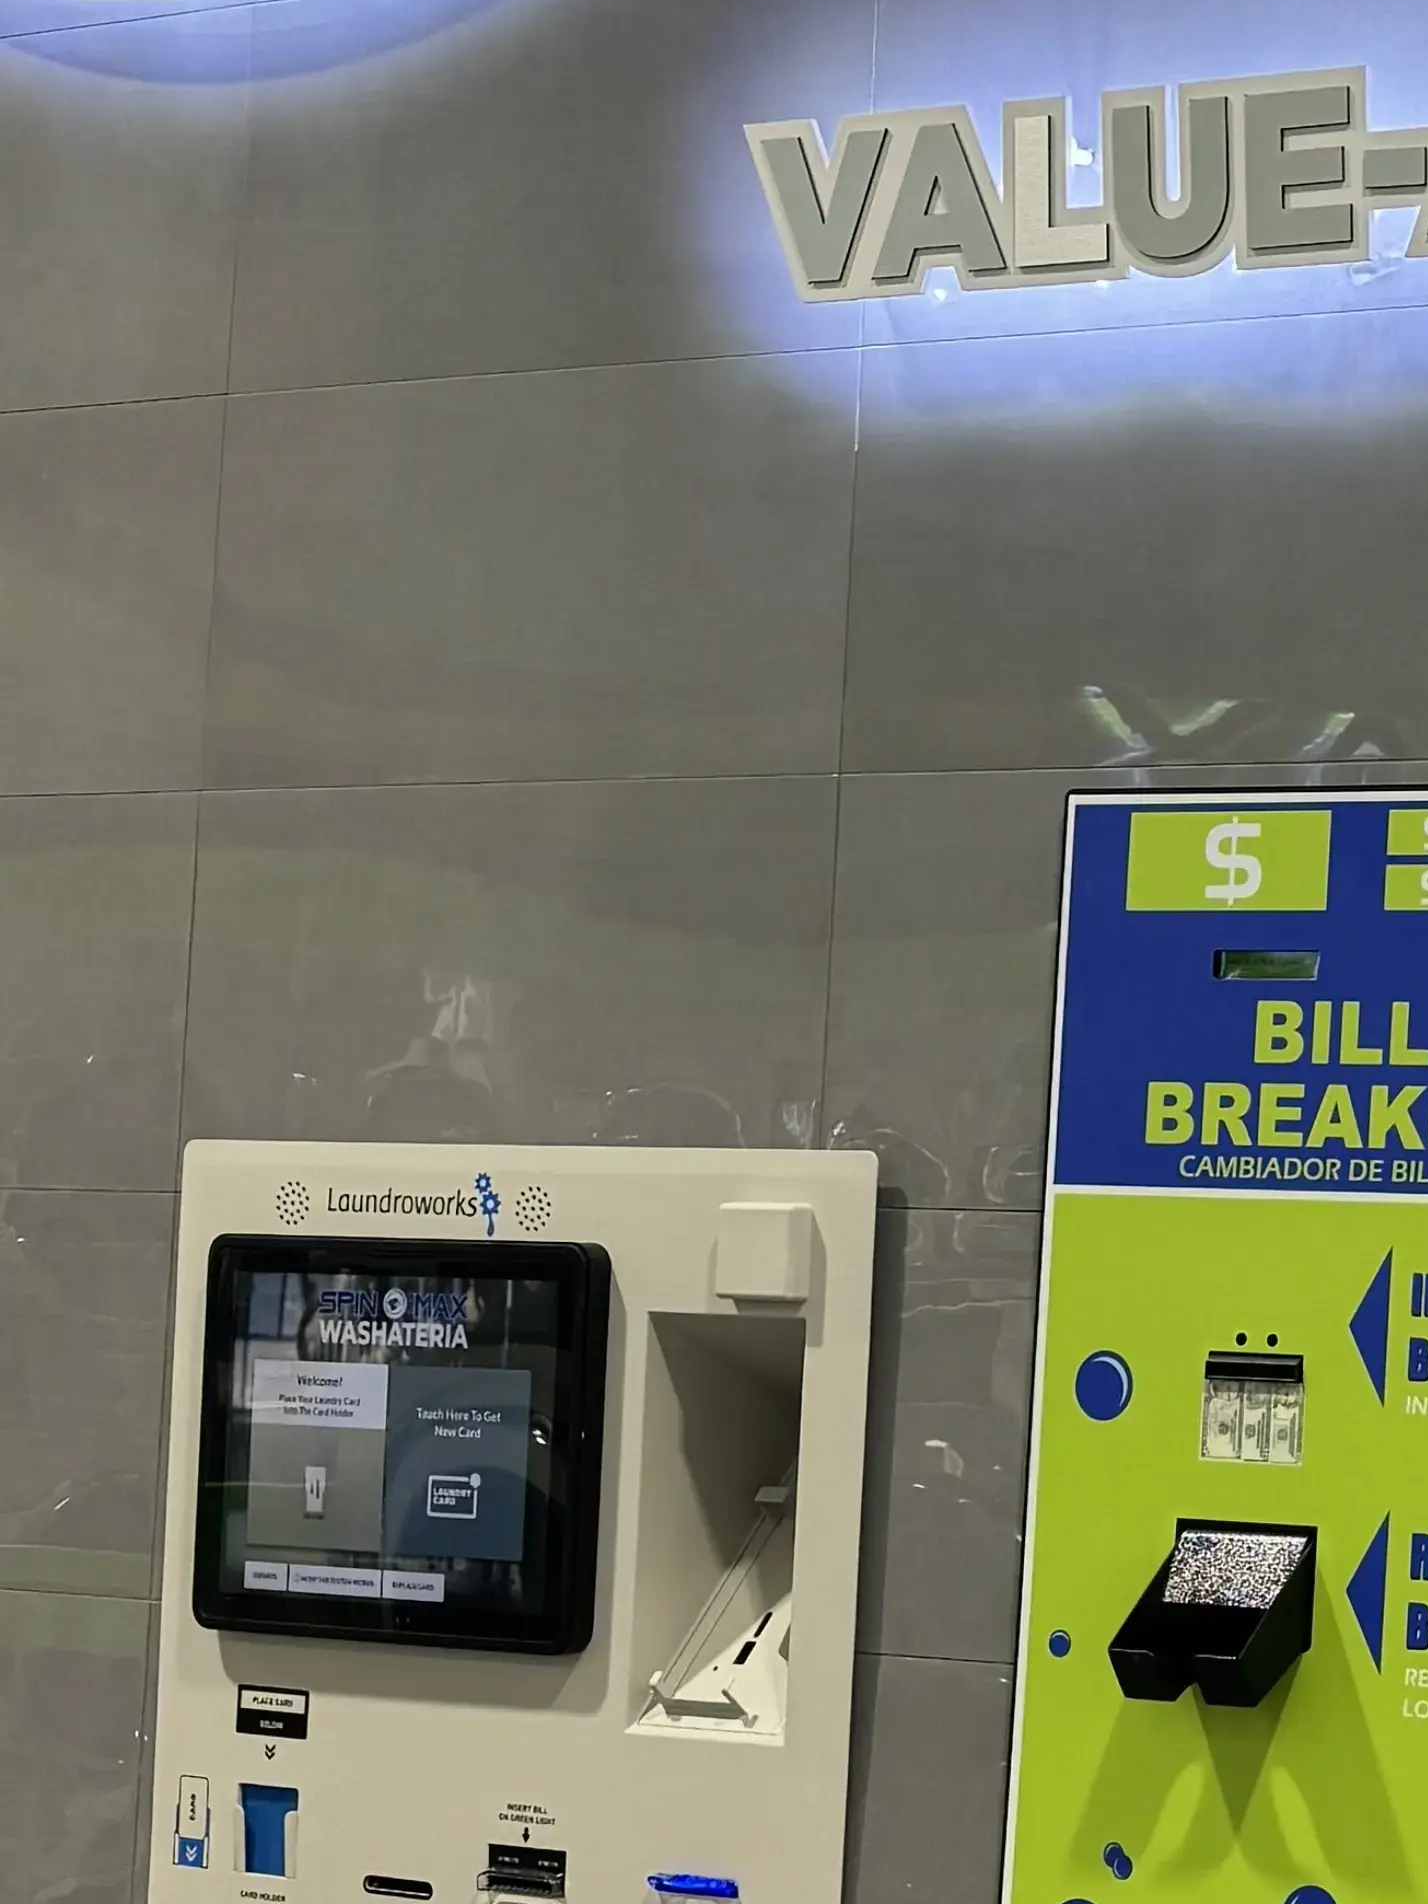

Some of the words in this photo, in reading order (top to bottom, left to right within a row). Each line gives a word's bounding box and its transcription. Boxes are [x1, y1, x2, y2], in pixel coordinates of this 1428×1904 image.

[1178, 1154, 1340, 1181] CAMBIADOR
[1348, 1158, 1384, 1182] DE
[327, 1187, 478, 1217] Laundroworks
[318, 1290, 379, 1317] SPIN
[412, 1293, 468, 1320] MAX
[320, 1319, 468, 1349] WASHATERIA
